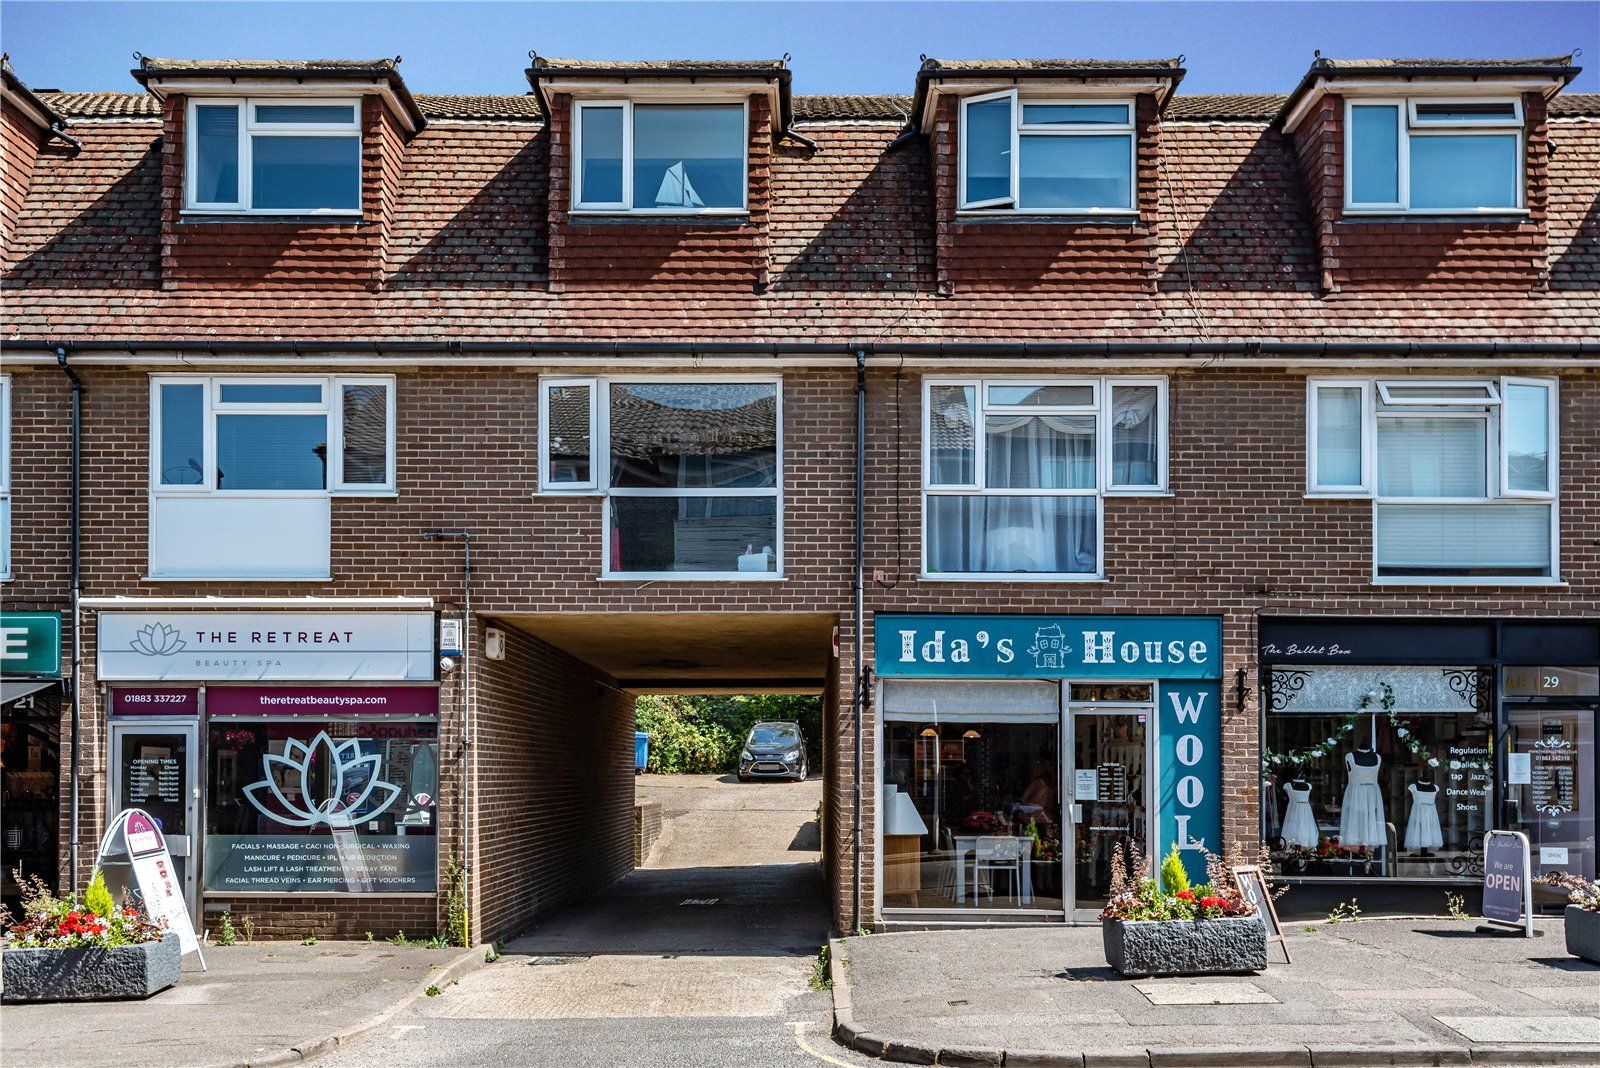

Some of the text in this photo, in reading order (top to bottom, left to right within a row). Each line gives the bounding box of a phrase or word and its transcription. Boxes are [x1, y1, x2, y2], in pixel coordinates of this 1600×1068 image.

[196, 632, 353, 643] THE RETREAT
[899, 630, 1207, 664] Ida's House
[1261, 643, 1352, 656] The Ballet Box
[1543, 676, 1559, 688] 29
[13, 695, 34, 709] 21
[124, 694, 187, 703] 01883 337227
[259, 696, 387, 706] theretreatbeautyspa.com
[1450, 746, 1488, 755] Regulation
[1167, 692, 1208, 850] WOOL
[1451, 773, 1463, 781] tap
[1446, 788, 1487, 796] Dance Wear
[1456, 803, 1478, 811] Shoes
[1493, 861, 1502, 870] We
[1485, 873, 1521, 892] OPEN
